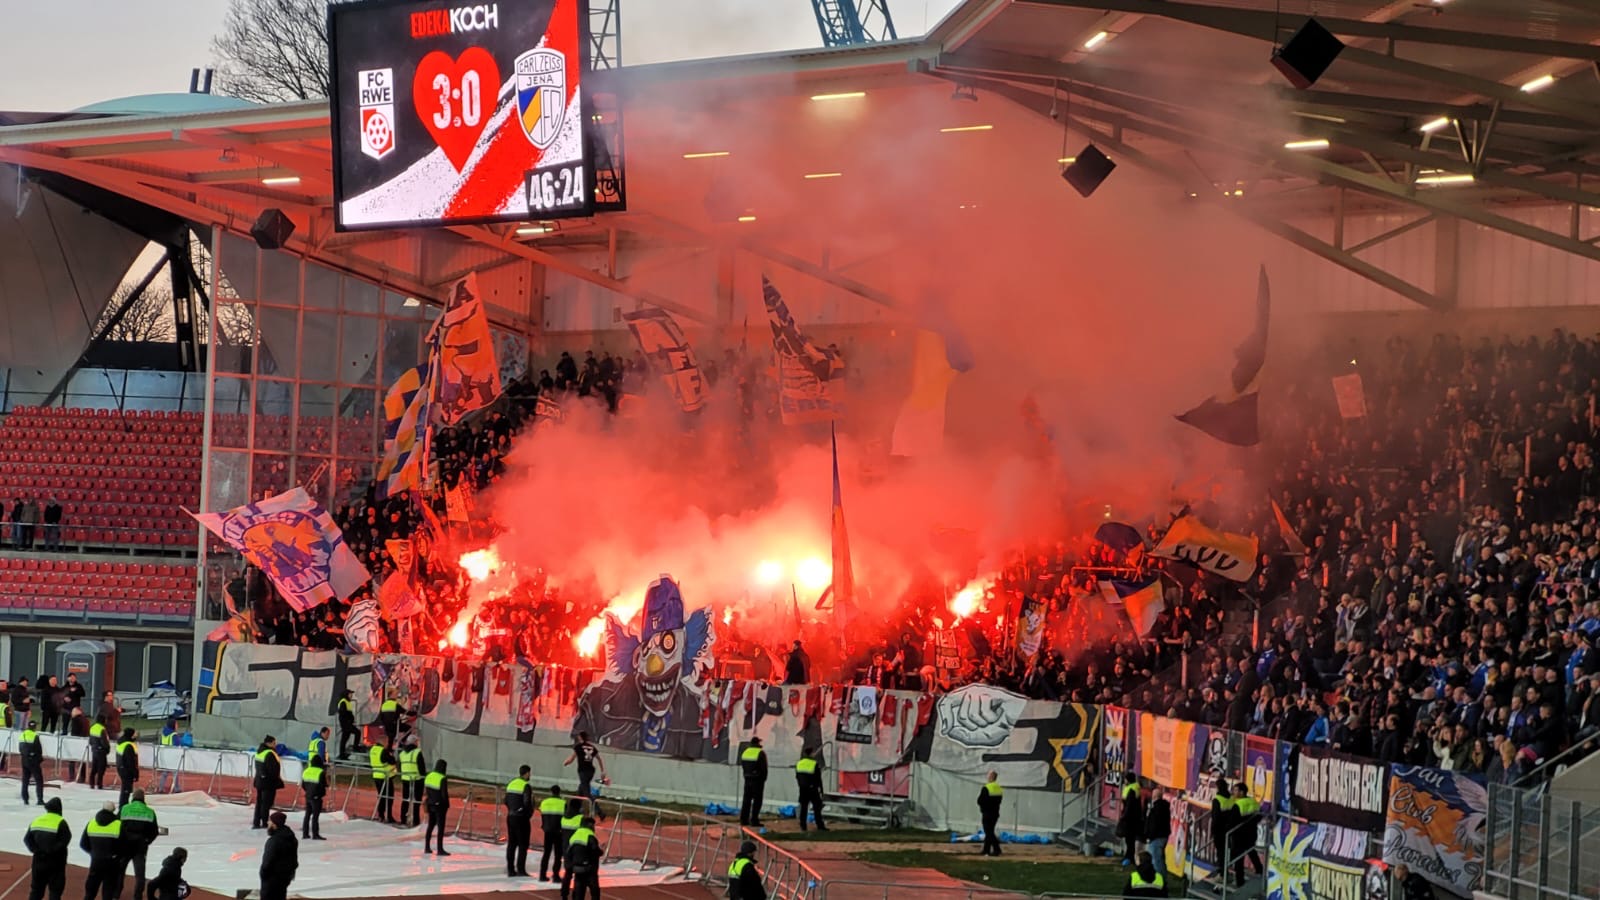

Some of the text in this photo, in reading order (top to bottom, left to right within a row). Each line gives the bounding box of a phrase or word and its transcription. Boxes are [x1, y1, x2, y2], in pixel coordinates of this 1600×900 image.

[367, 73, 384, 86] FC
[527, 75, 554, 86] JENA
[362, 88, 390, 103] RWE
[432, 70, 480, 130] 3:0
[529, 167, 583, 209] 46:24
[1391, 787, 1437, 824] Club
